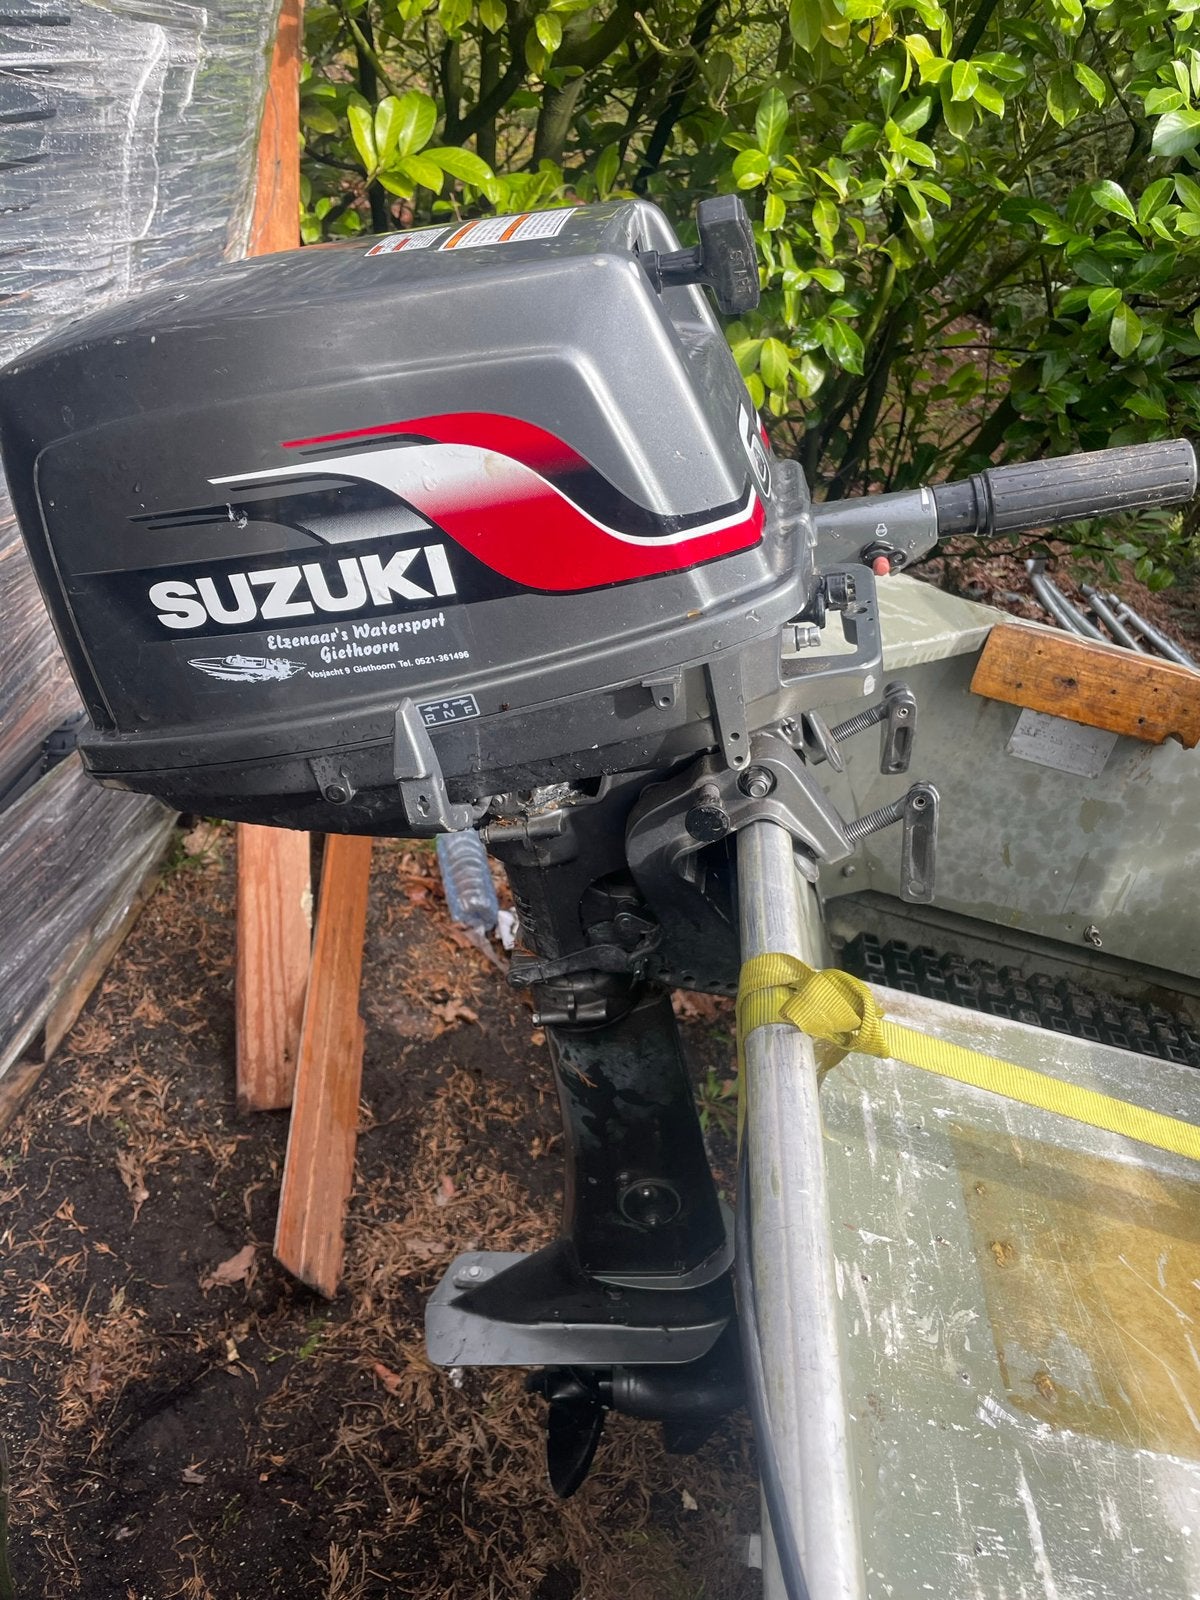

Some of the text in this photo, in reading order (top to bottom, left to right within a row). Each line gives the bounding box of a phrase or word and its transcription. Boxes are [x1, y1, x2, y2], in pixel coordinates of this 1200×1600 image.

[148, 543, 457, 629] SUZUKI
[267, 612, 446, 650] Elzenaar's Watersport
[307, 650, 470, 679] Vosjacht 9 Giethoorn Tel. 0521-361496
[320, 641, 400, 664] Giethoorn
[424, 704, 473, 725] R N F
